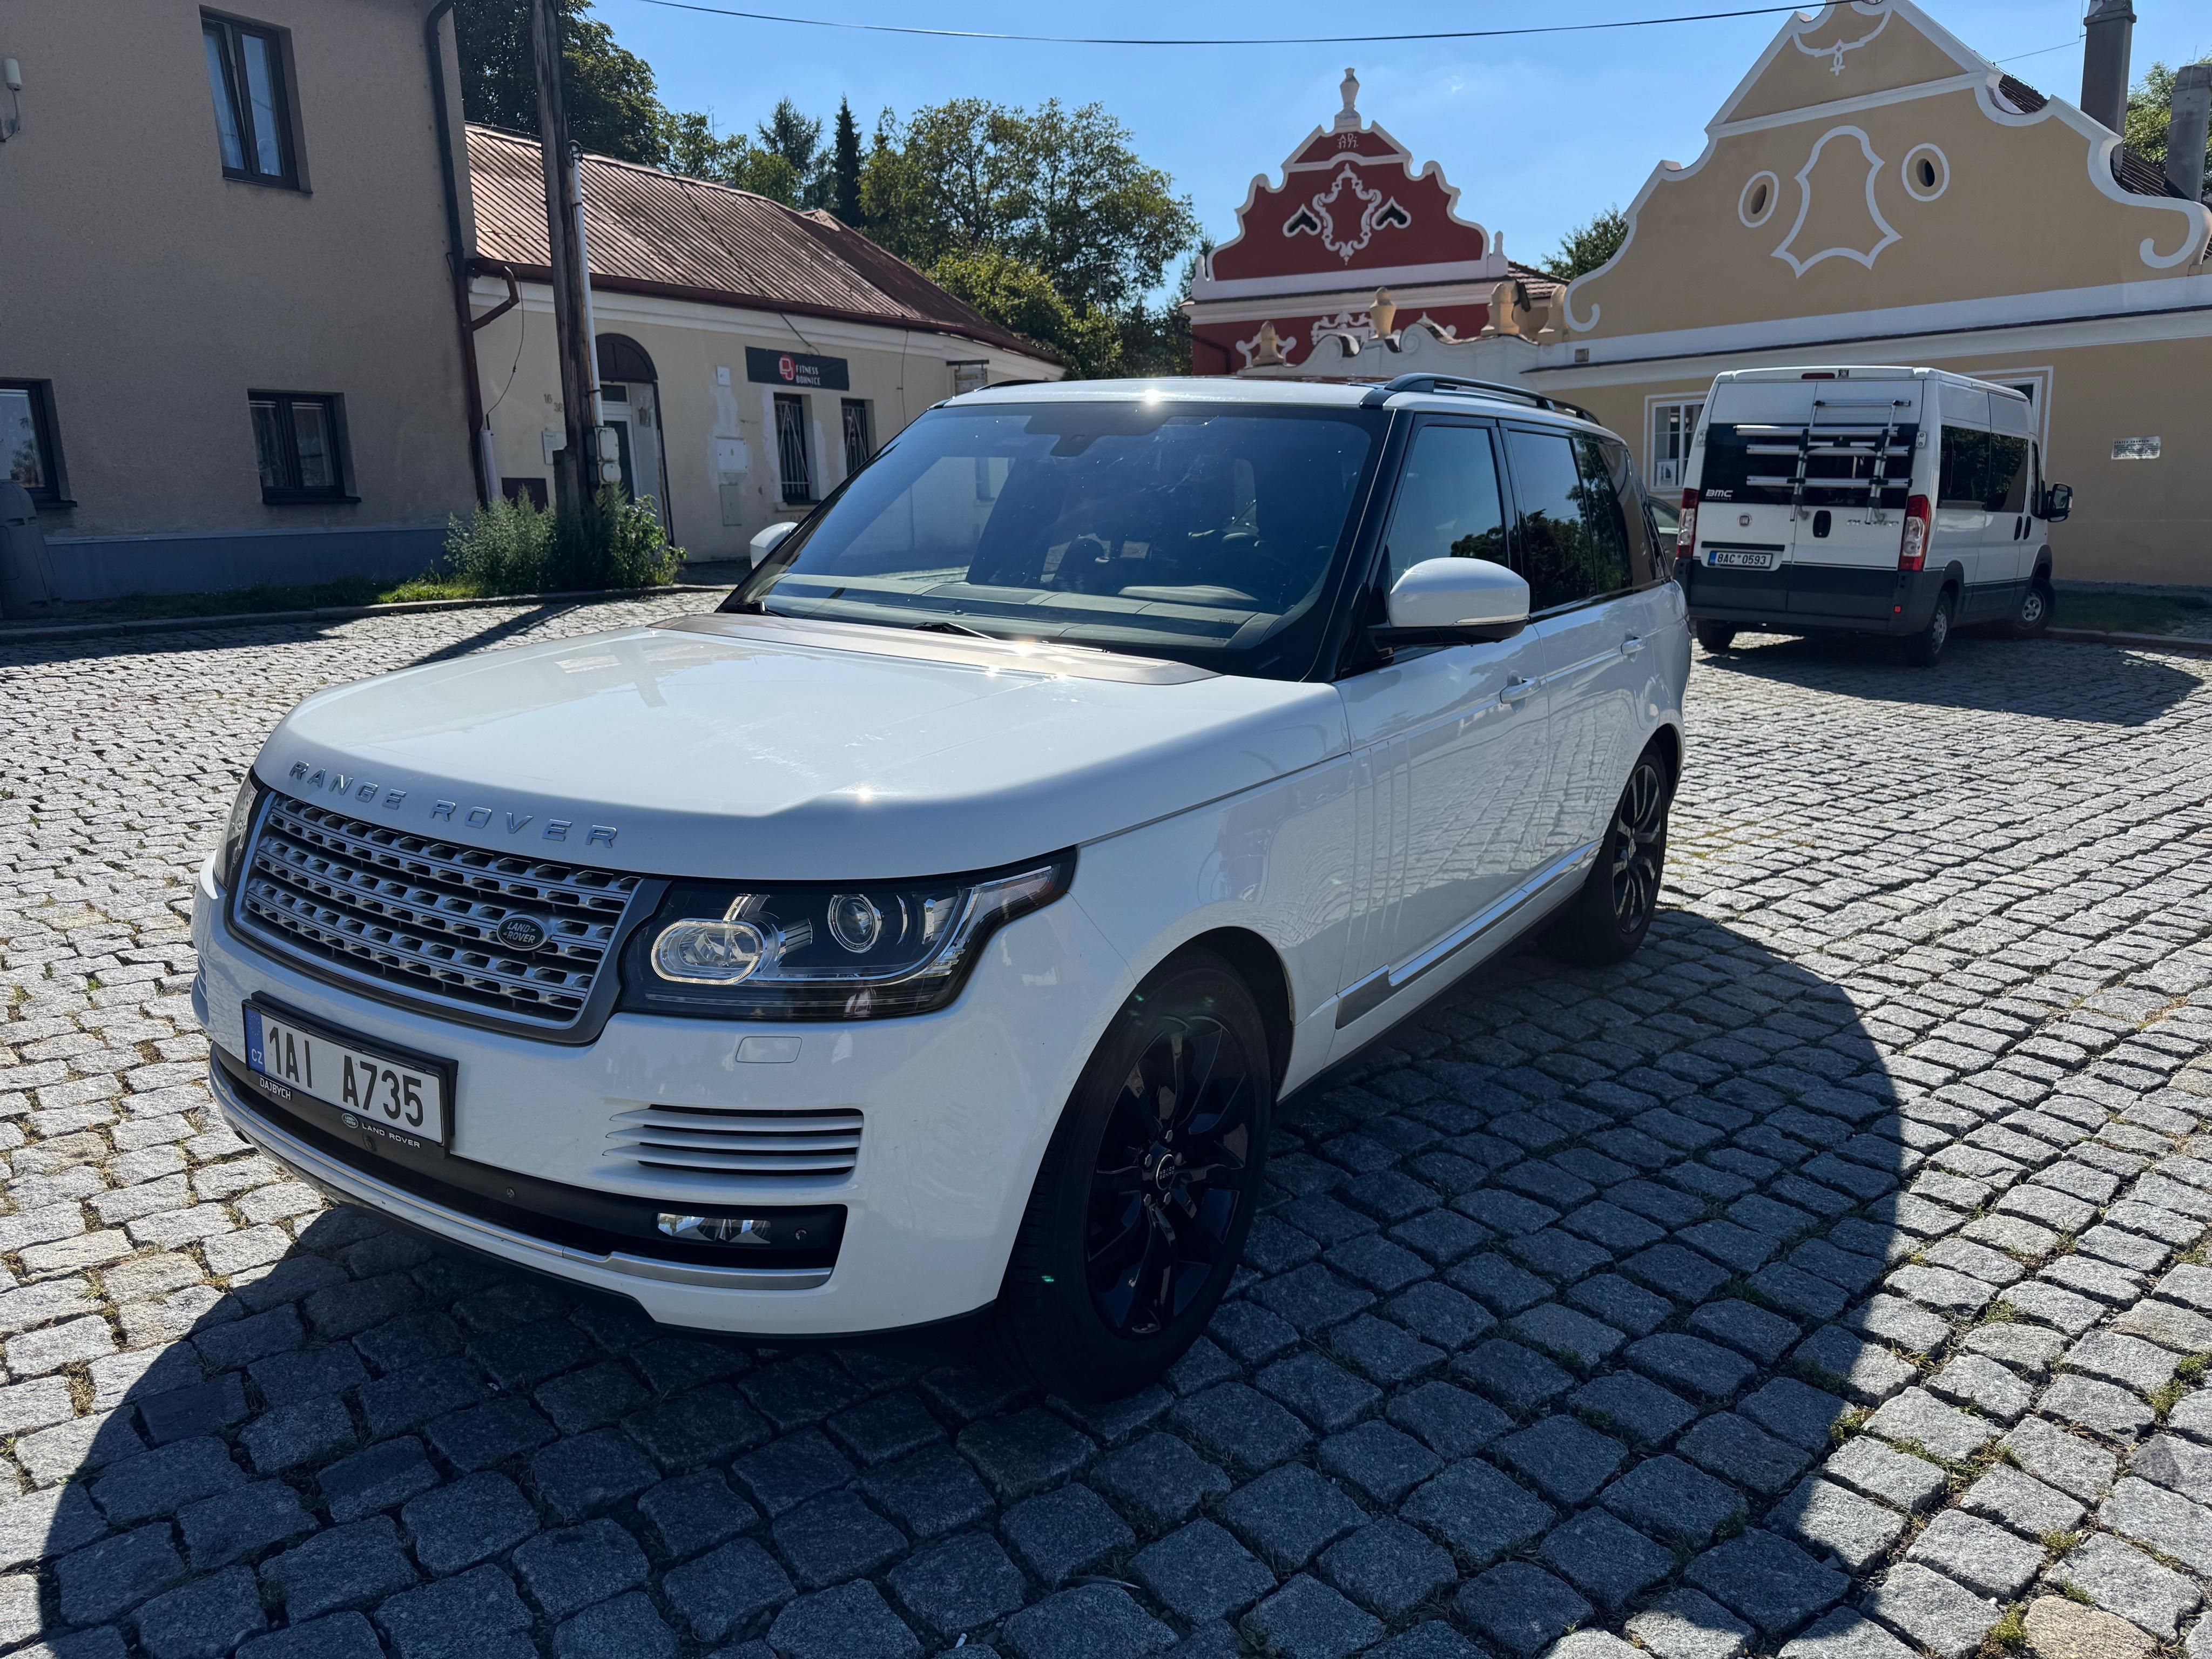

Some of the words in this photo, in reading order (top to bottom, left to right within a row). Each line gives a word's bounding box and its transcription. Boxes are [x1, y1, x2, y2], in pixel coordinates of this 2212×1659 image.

[795, 365, 819, 375] FITNESS
[1705, 489, 1734, 497] BMC
[1717, 554, 1735, 563] 8AC
[1742, 555, 1766, 565] 0593
[288, 759, 407, 810] RANGE
[428, 799, 618, 848] ROVER
[251, 1048, 263, 1065] CZ
[269, 1027, 313, 1089] 1AI
[342, 1054, 424, 1128] A735
[260, 1077, 292, 1101] DAJBYCH
[362, 1123, 385, 1136] LAND
[389, 1132, 421, 1148] ROVER
